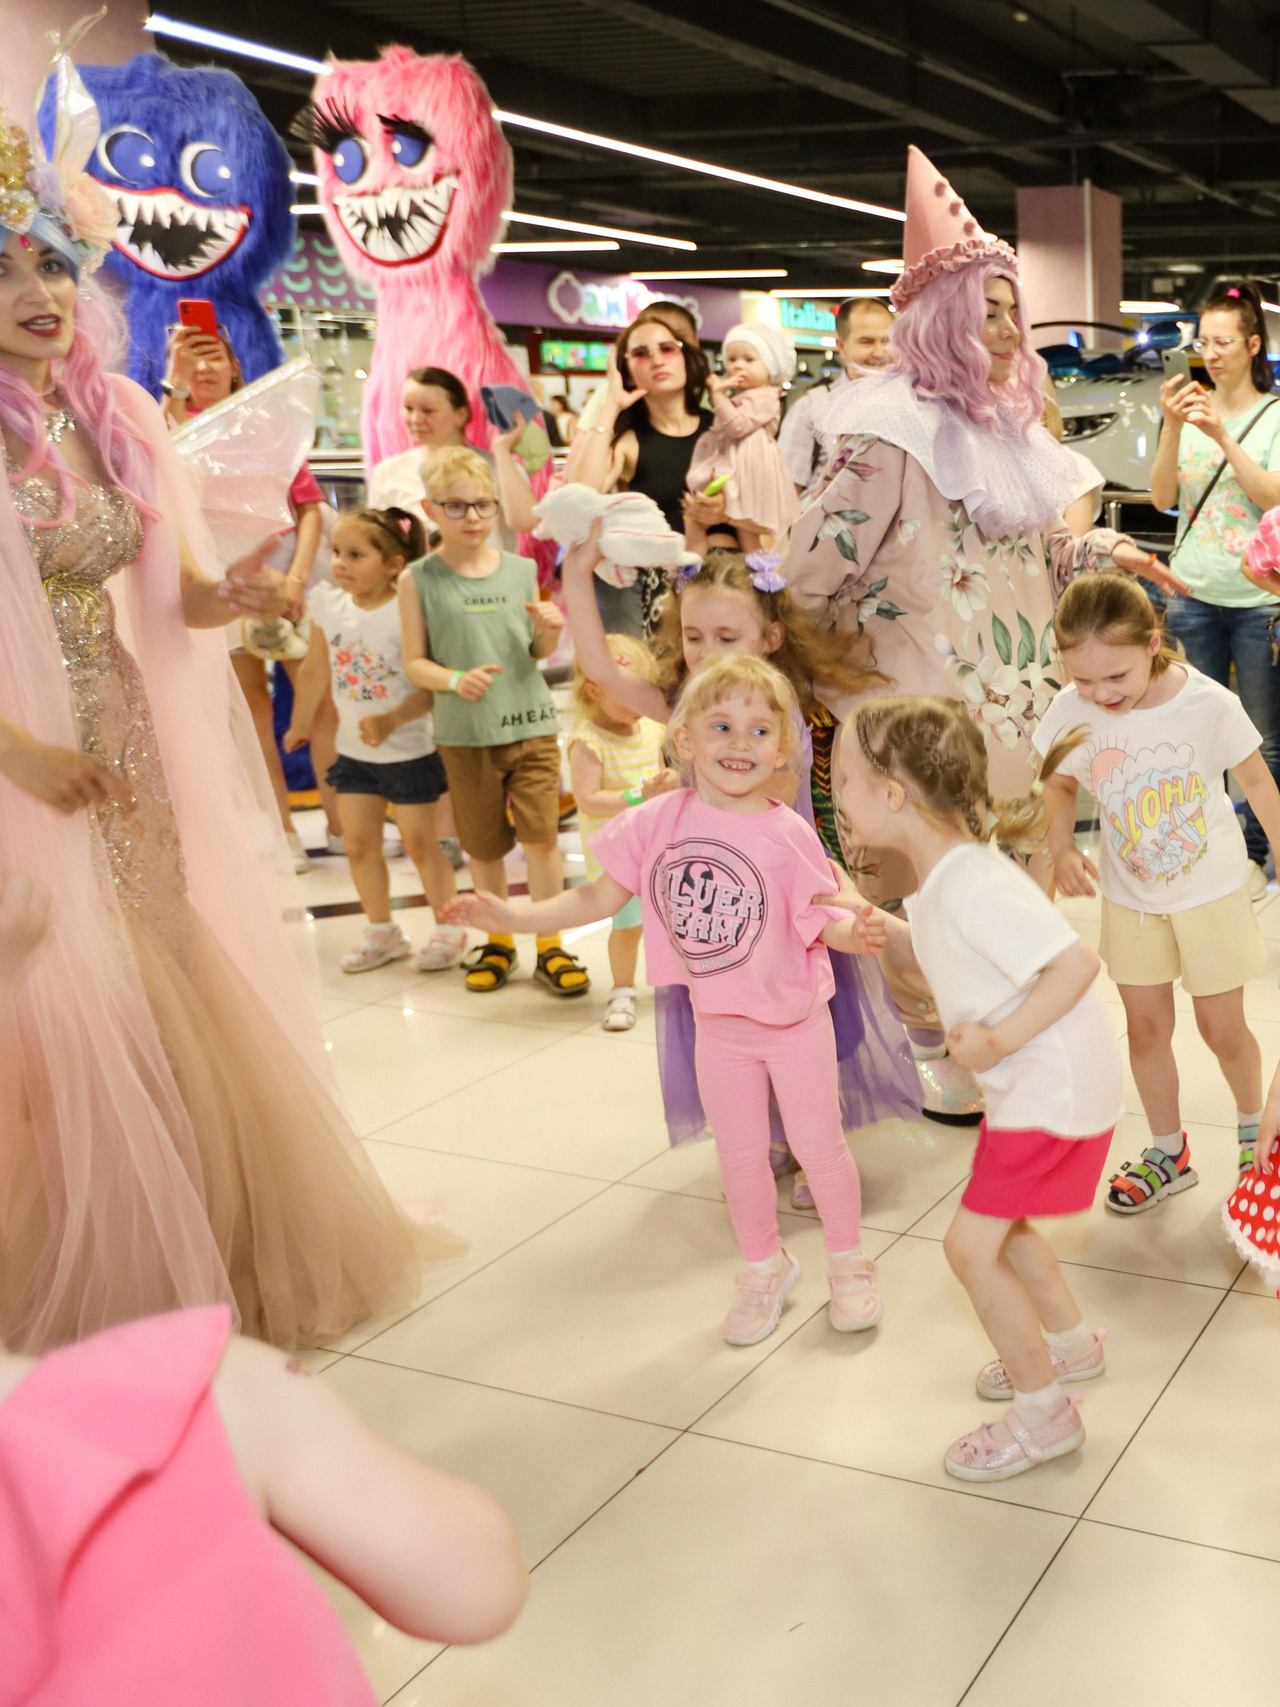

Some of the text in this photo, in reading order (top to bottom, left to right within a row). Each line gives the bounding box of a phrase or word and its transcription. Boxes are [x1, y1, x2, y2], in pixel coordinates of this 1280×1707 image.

[781, 298, 837, 332] Italian
[670, 904, 740, 947] EAM
[701, 953, 735, 973] KIDS
